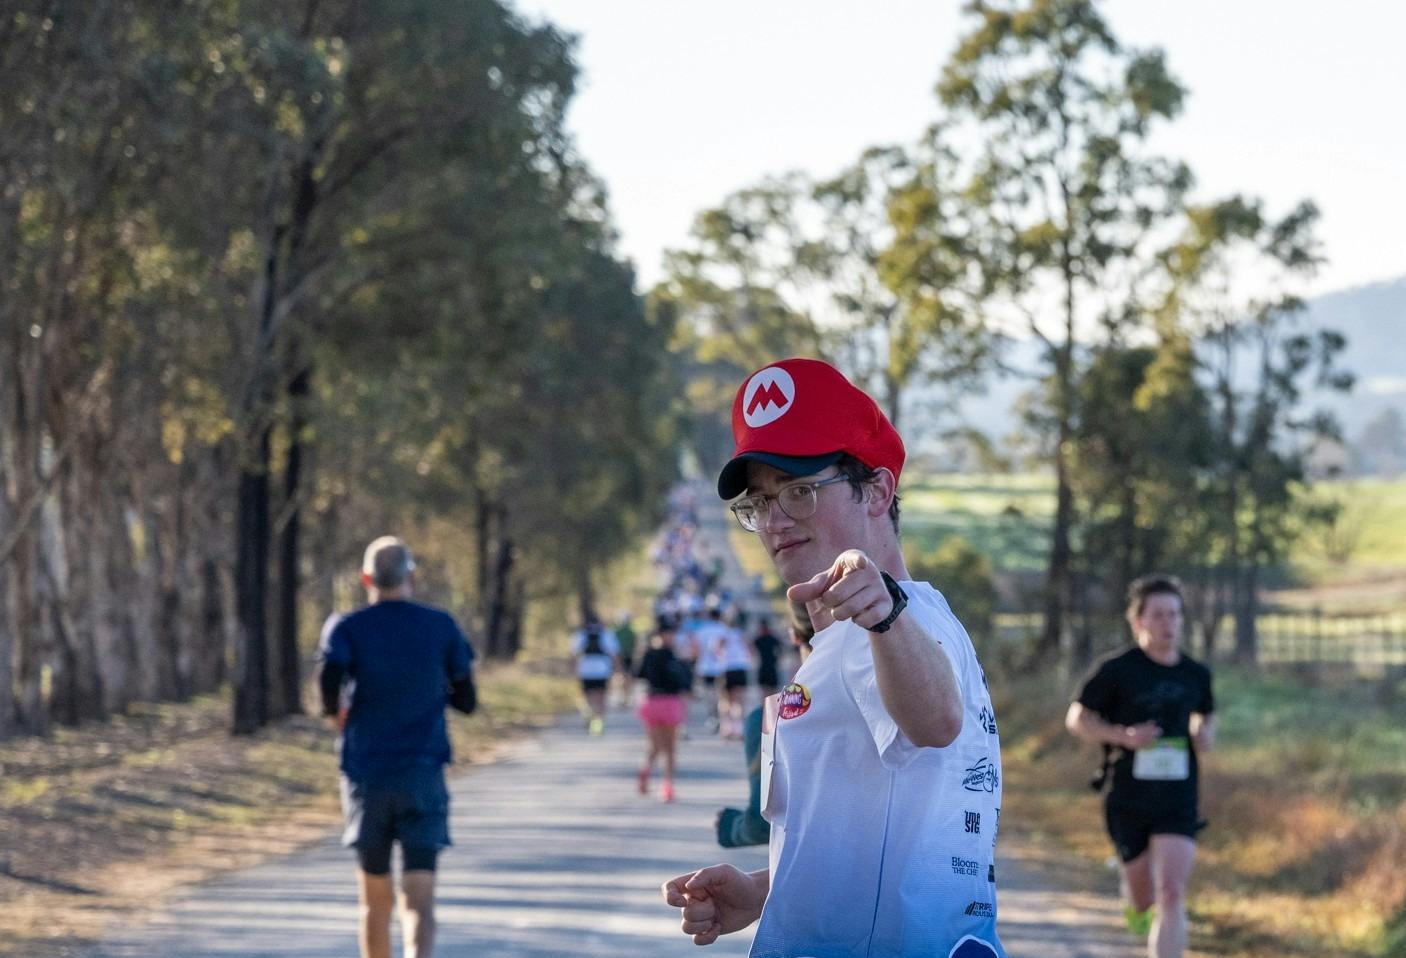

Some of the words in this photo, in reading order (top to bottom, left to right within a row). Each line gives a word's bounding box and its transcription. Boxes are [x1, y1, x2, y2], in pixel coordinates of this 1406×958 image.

[746, 380, 789, 416] M
[965, 810, 980, 823] IMA
[965, 821, 980, 834] SIG
[952, 857, 980, 868] Bloom
